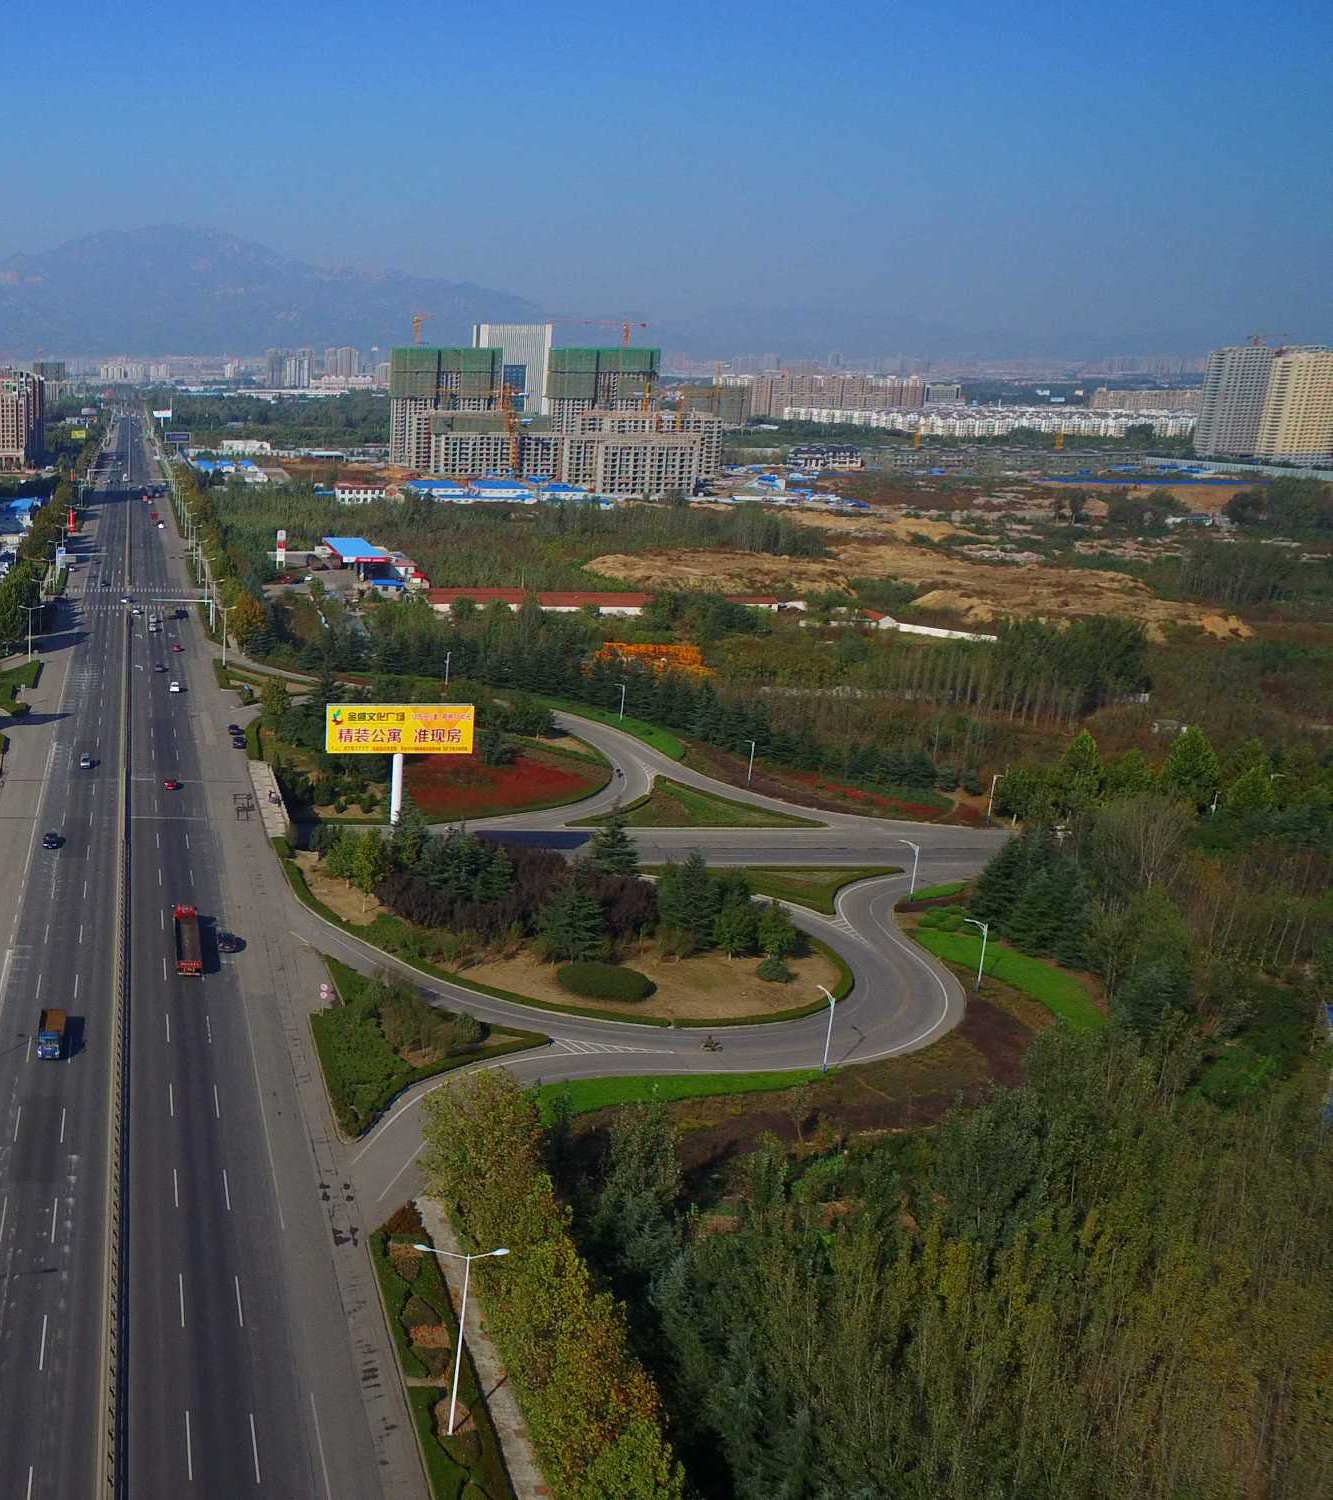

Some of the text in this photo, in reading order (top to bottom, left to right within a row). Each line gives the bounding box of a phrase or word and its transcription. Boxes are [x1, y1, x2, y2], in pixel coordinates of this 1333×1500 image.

[338, 728, 462, 743] 精装公寓 准现房
